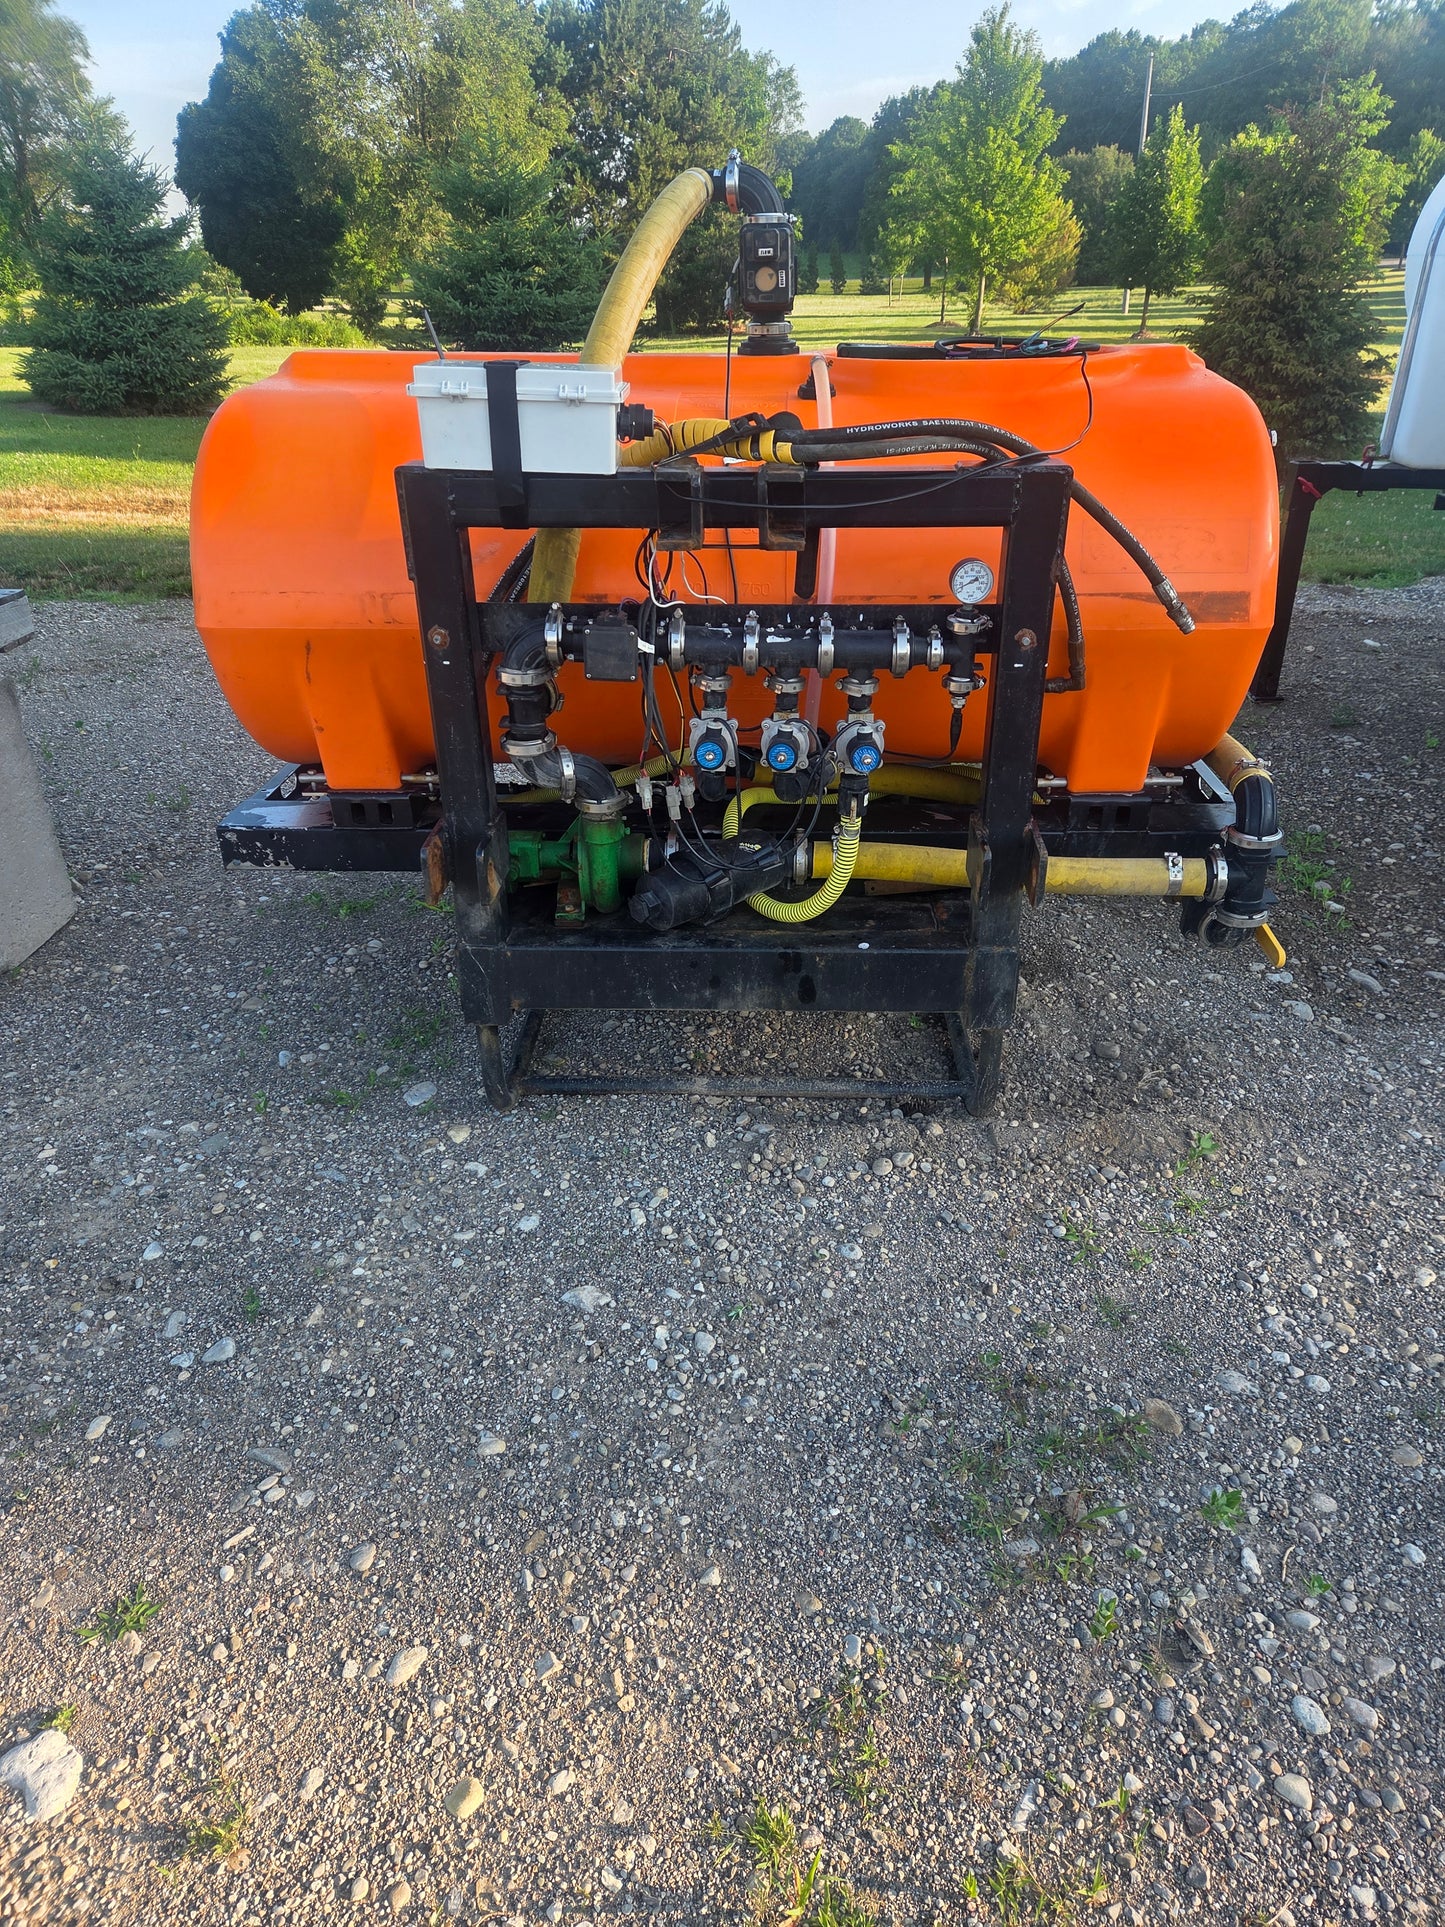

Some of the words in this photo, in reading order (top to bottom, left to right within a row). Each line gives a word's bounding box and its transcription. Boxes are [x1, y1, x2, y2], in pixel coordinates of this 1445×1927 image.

[846, 420, 919, 434] HYDROWORKS
[922, 419, 975, 427] SAE100R2AT
[740, 581, 771, 597] 760
